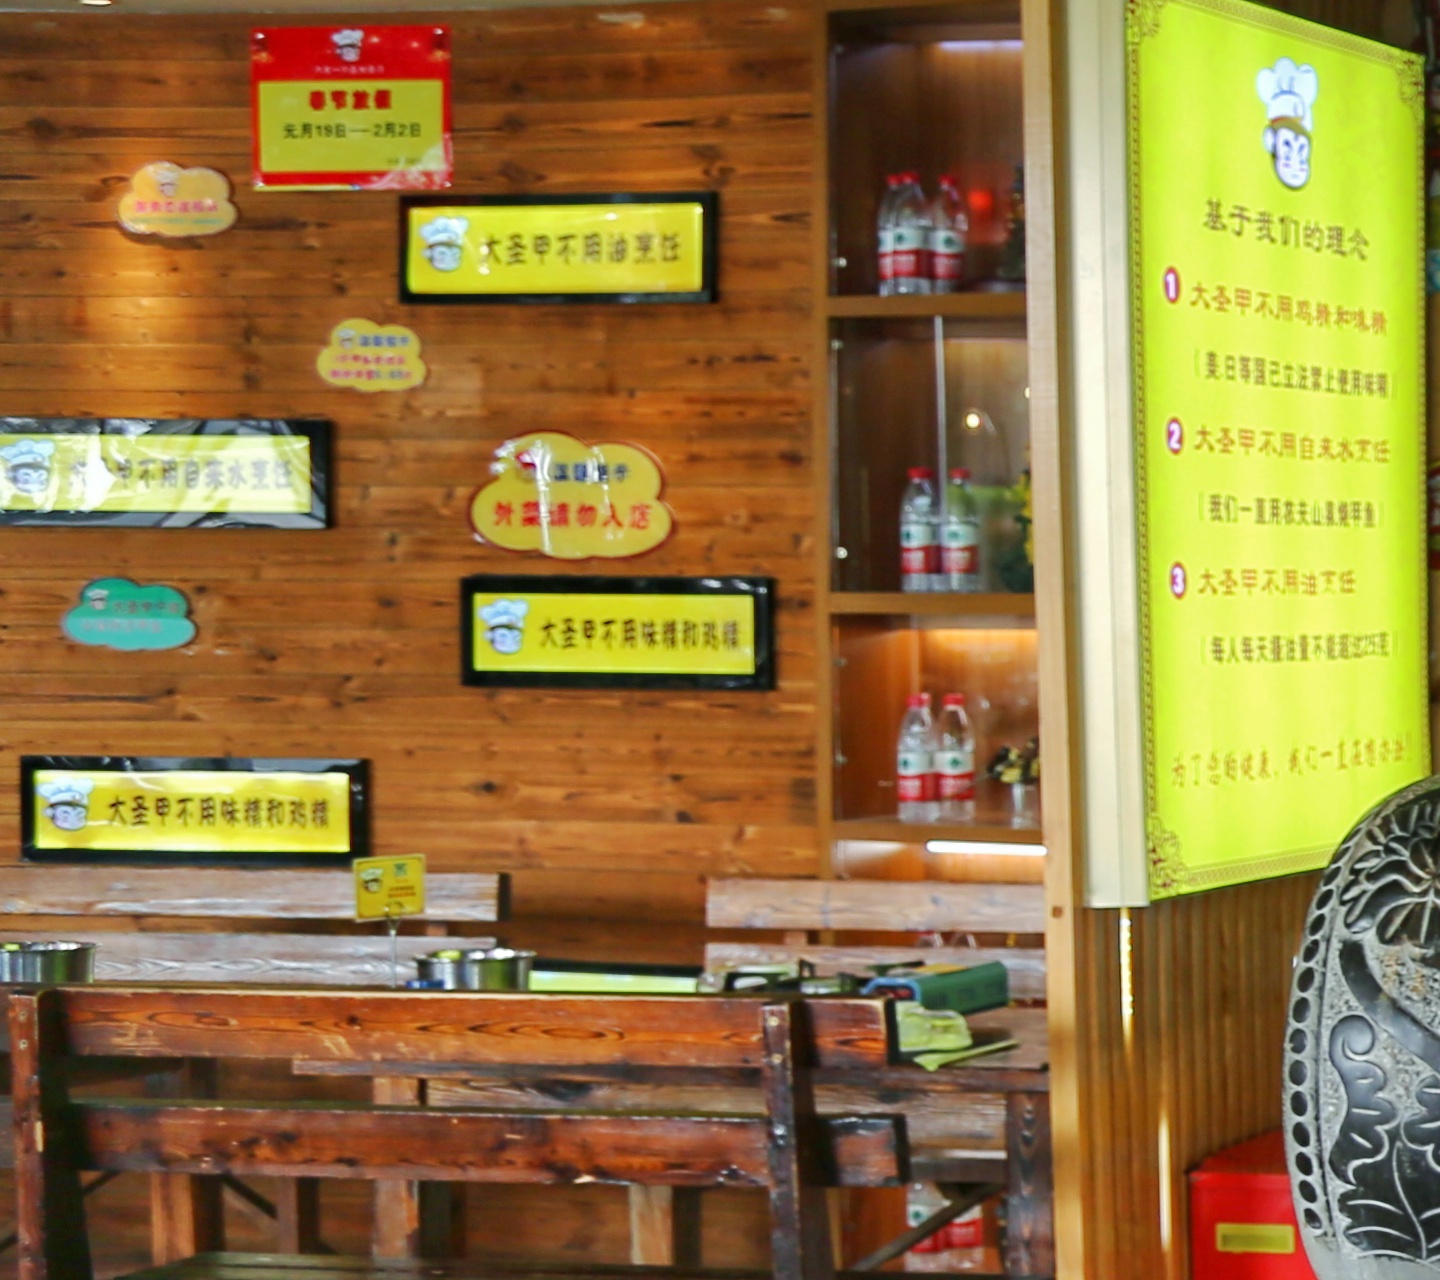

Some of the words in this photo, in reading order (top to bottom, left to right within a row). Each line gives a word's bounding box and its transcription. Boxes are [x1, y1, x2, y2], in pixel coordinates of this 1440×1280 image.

[1201, 197, 1371, 262] 基于我们的理念
[484, 231, 682, 266] 大圣甲不用油烹饪
[69, 458, 294, 490] 甲不用自来水烹饪
[540, 618, 741, 651] 大圣甲不用味精和鸡精
[108, 796, 330, 830] 大圣甲不用味精和鸡精
